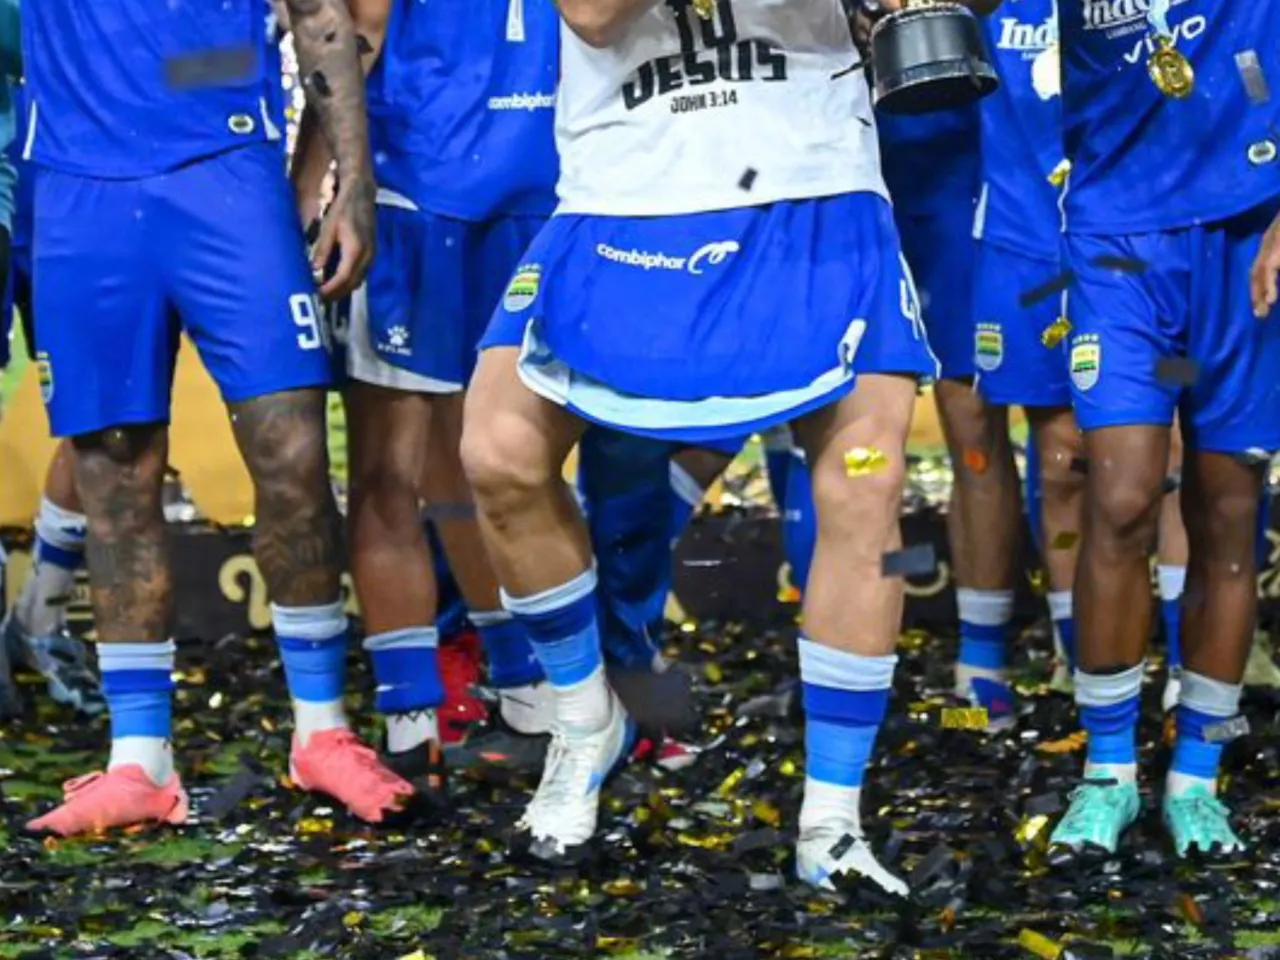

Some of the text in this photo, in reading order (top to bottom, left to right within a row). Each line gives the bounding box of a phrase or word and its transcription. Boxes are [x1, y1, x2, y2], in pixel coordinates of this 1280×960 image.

[620, 40, 787, 110] JESUS
[670, 93, 707, 113] JOHN
[597, 243, 686, 270] combiphar
[289, 293, 321, 350] 9
